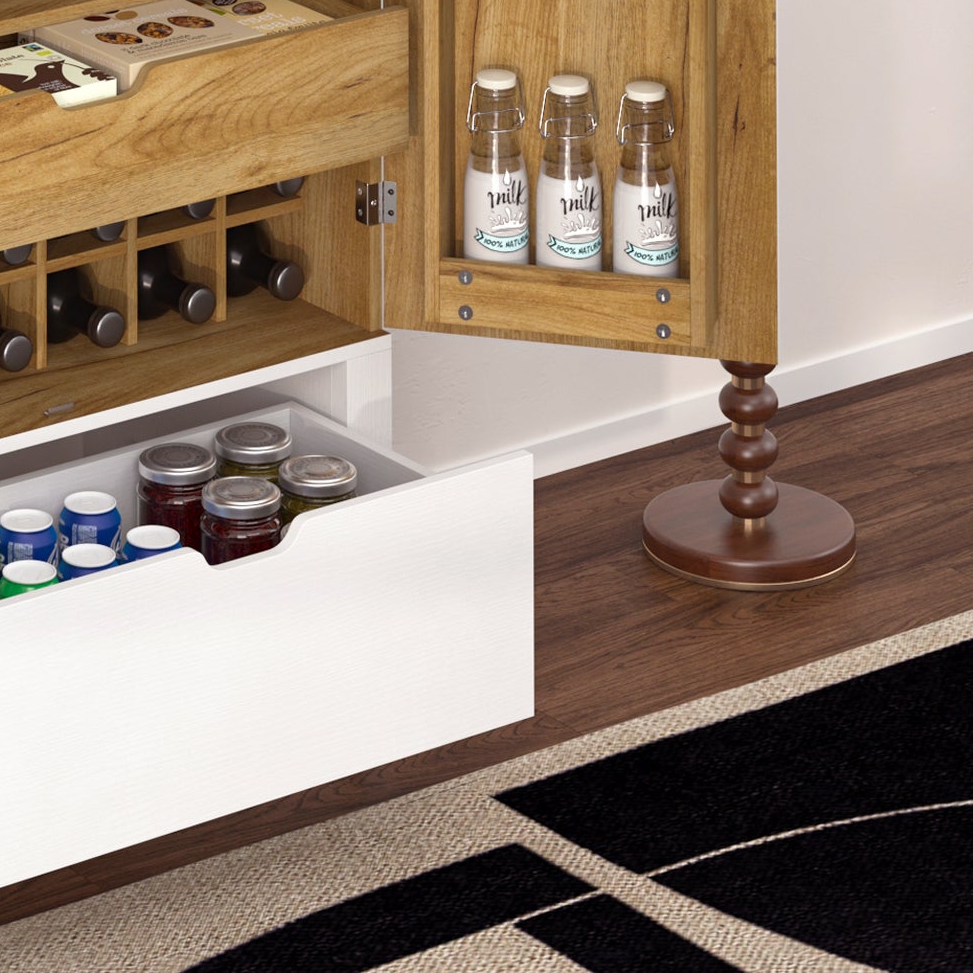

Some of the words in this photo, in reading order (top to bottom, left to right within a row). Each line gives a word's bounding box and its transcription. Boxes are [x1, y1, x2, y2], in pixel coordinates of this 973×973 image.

[487, 180, 527, 208] milk
[560, 186, 600, 215] milk
[638, 193, 677, 222] milk
[484, 238, 503, 248] 100%
[556, 244, 576, 255] 100%
[634, 251, 654, 261] 100%
